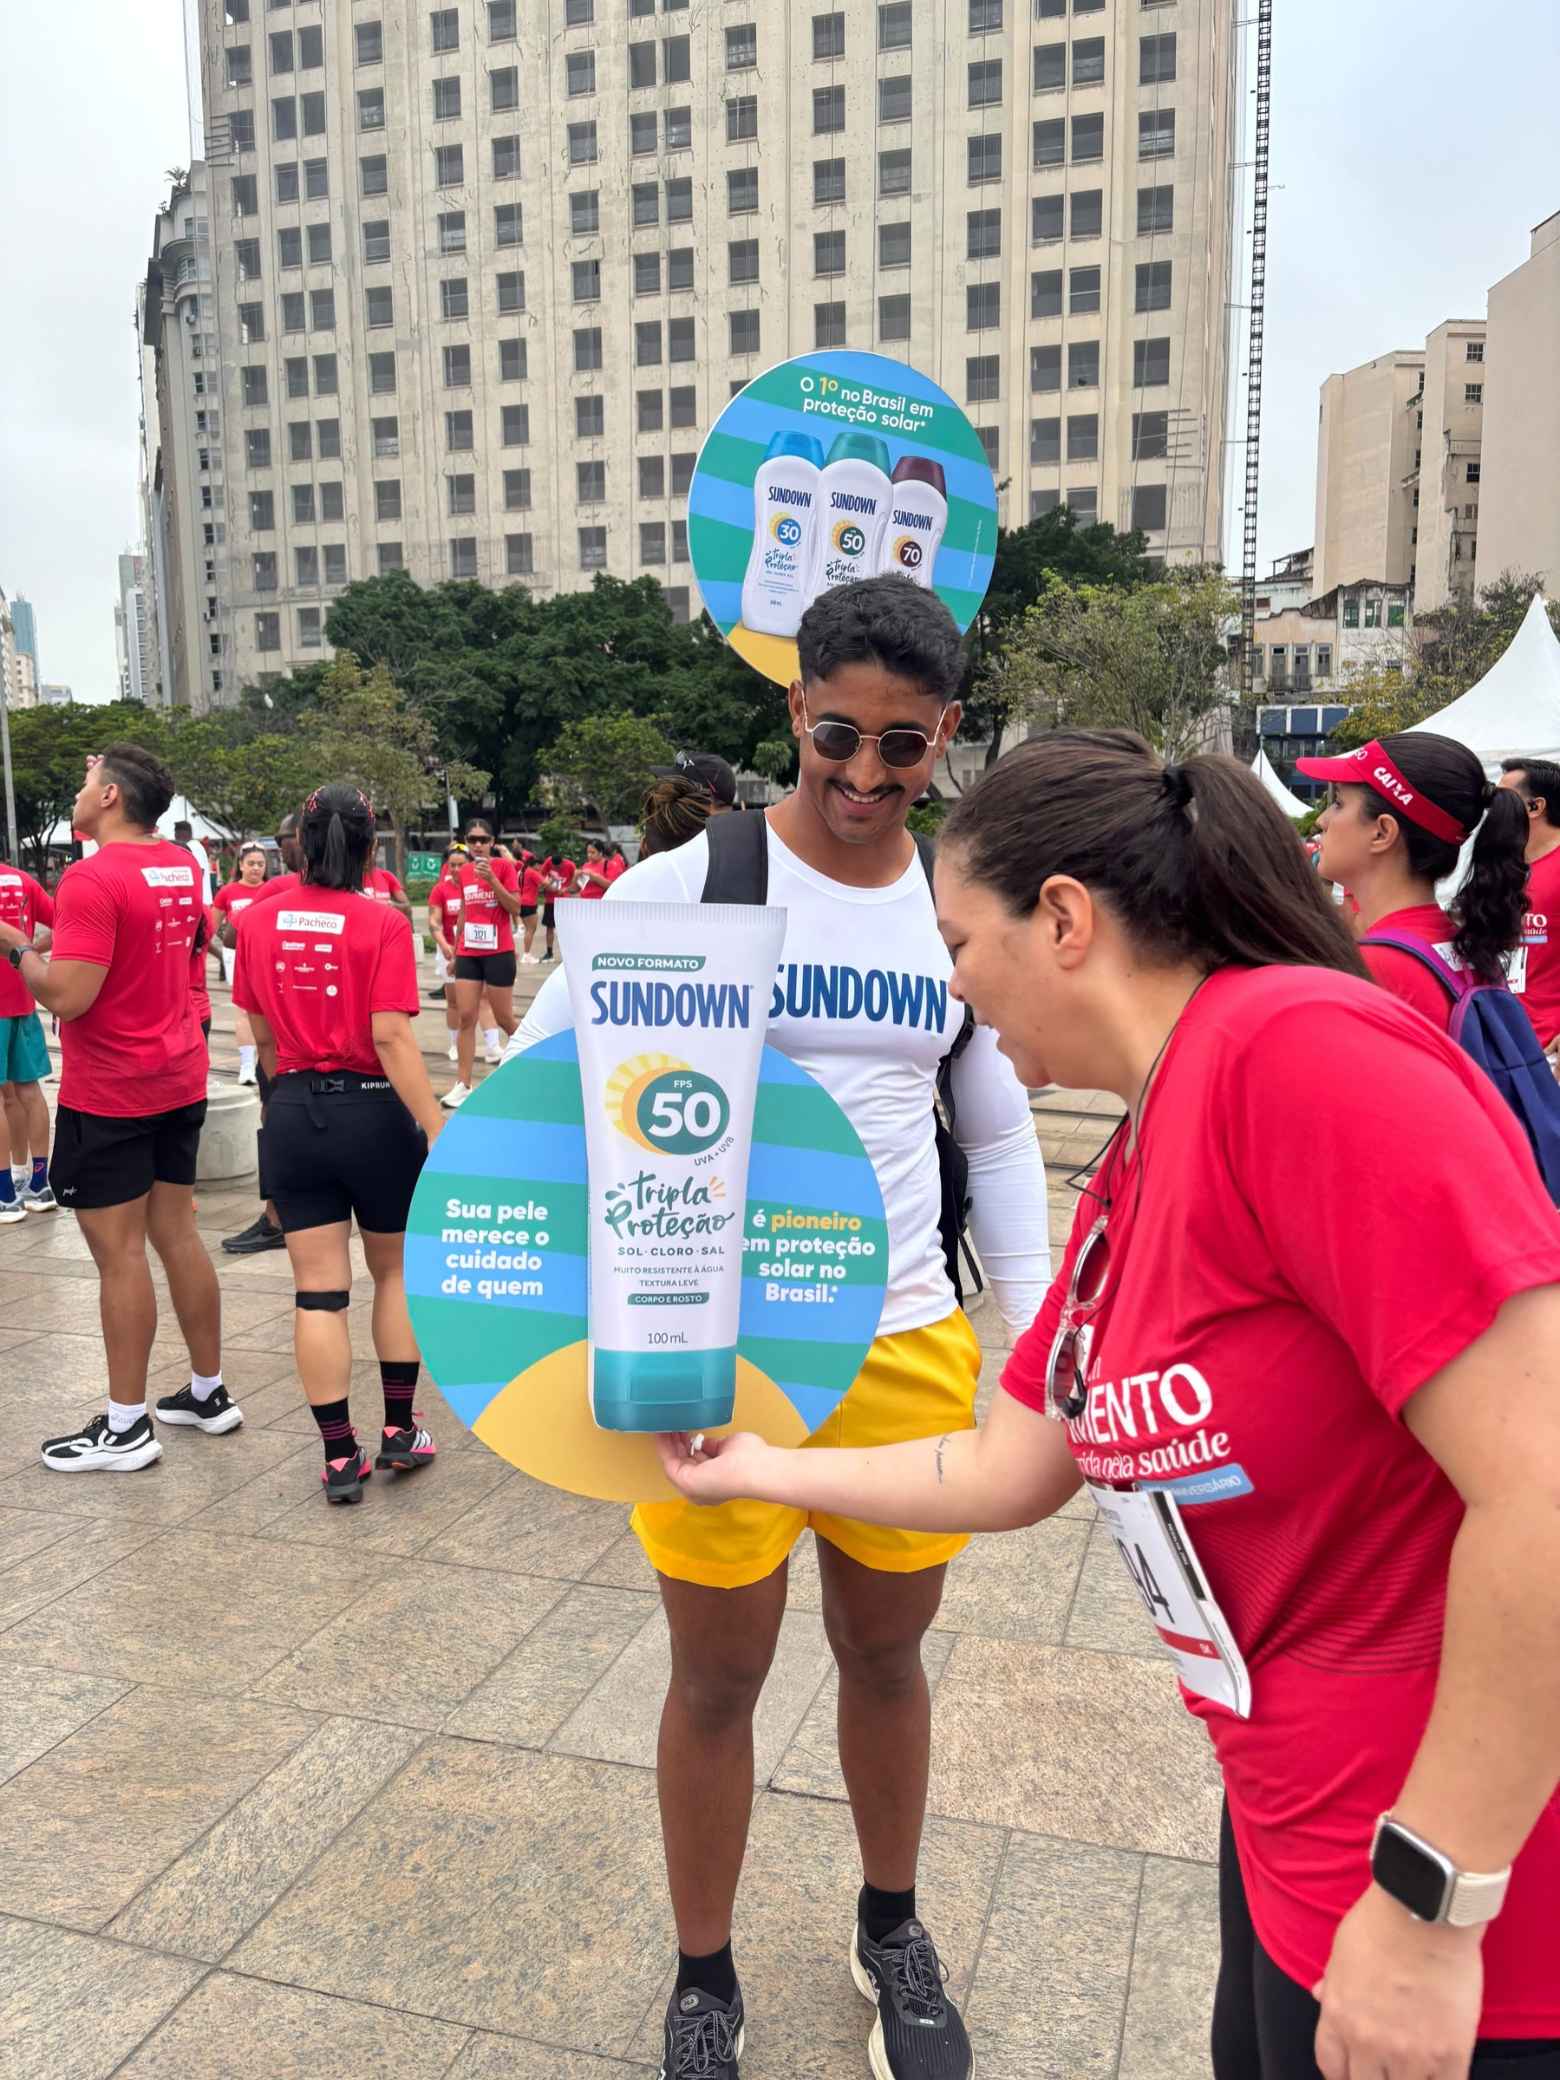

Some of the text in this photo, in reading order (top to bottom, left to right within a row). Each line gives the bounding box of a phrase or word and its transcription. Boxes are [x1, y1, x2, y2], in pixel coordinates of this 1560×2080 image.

[800, 376, 814, 392] O
[841, 388, 860, 402] no
[862, 388, 906, 412] Brasil
[909, 402, 934, 418] em
[803, 397, 877, 422] proteção
[768, 486, 812, 508] SUNDOWN
[830, 491, 877, 515] SUNDOWN
[892, 509, 933, 531] SUNDOWN
[779, 524, 800, 541] 30
[842, 533, 863, 551] 50
[903, 547, 921, 563] 70
[1373, 767, 1413, 805] CAIXA
[299, 917, 337, 929] Pacheco
[597, 956, 698, 970] NOVO FORMATO
[590, 980, 750, 1028] SUNDOWN
[673, 1079, 693, 1089] FPS
[648, 1091, 721, 1138] 50
[694, 1154, 714, 1166] UVA
[719, 1136, 735, 1153] UVB
[628, 1170, 712, 1211] Tripla
[446, 1198, 549, 1224] Sua pele
[604, 1200, 736, 1240] Proteção
[752, 1208, 862, 1233] é pioneiro
[441, 1228, 550, 1246] merece o
[775, 1236, 876, 1260] proteção
[445, 1248, 542, 1271] cuidado
[701, 1264, 724, 1273] ÁGUA
[758, 1257, 847, 1279] solar no
[441, 1274, 544, 1300] de quem
[678, 1279, 699, 1287] LEVE
[673, 1295, 703, 1303] ROSTO
[648, 1331, 688, 1344] 100 mL
[1138, 1429, 1231, 1476] saúde
